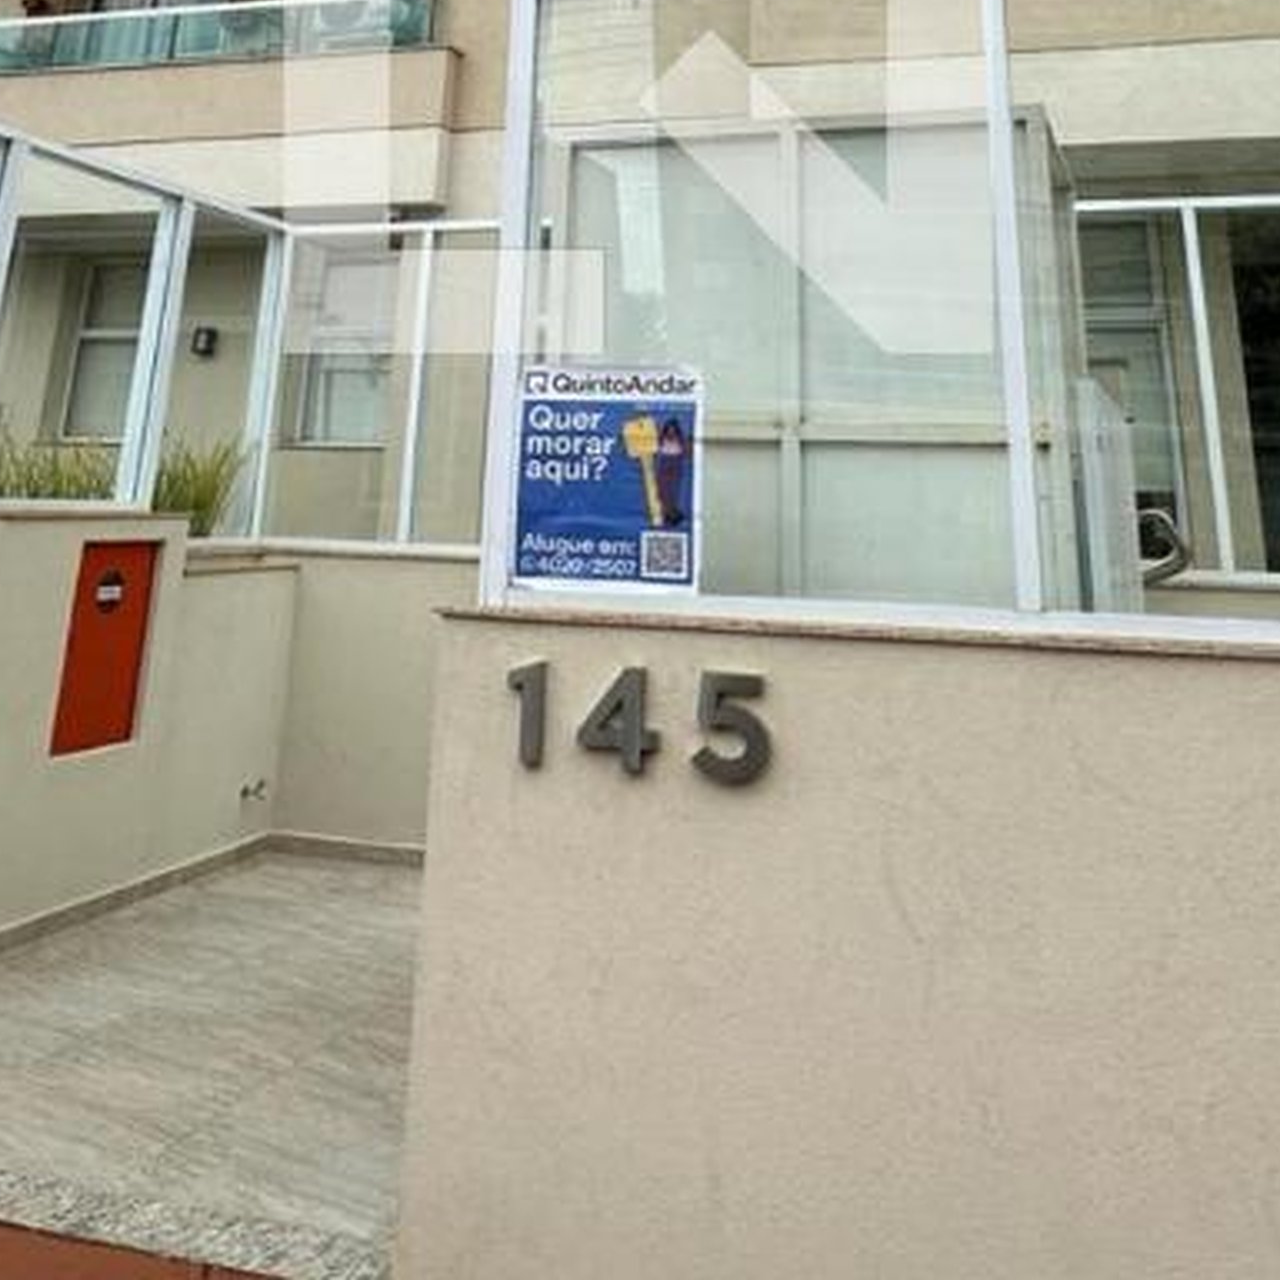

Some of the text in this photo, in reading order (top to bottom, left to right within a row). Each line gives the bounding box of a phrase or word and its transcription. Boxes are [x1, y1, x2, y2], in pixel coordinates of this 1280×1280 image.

[552, 372, 696, 395] QuintoAndar
[528, 404, 604, 431] Quer
[526, 434, 615, 456] morar
[524, 455, 609, 486] aqui?
[521, 532, 595, 556] Alugue
[506, 658, 772, 787] 145
